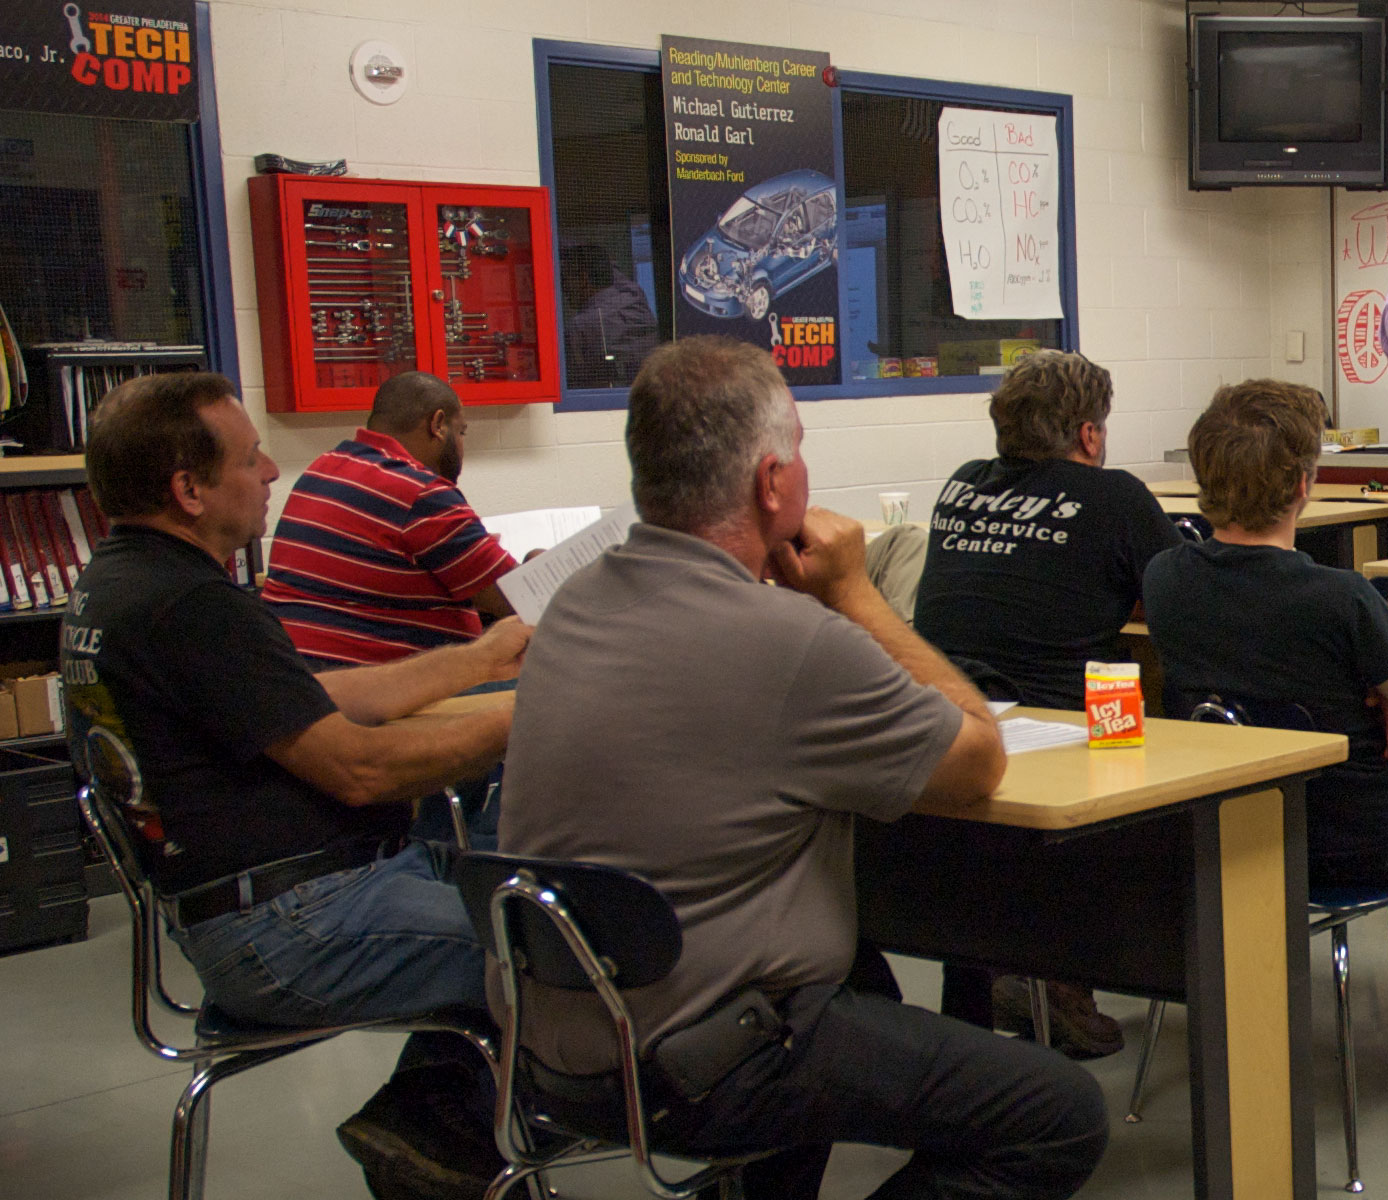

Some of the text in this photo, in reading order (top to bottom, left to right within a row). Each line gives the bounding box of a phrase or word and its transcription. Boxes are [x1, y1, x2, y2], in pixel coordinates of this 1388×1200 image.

[110, 14, 139, 26] GREATER
[141, 17, 189, 31] PHILADELPHIA
[41, 45, 65, 63] Jr.
[88, 22, 191, 63] TECH
[71, 52, 191, 95] COMP
[669, 47, 816, 77] Reading/Muhlenberg Career
[671, 70, 790, 94] and Technology Center
[673, 96, 795, 122] Michael Gutierrez
[674, 122, 754, 145] Ronald Garl
[947, 120, 981, 146] Good
[675, 150, 729, 167] Sponsored by
[727, 170, 744, 183] Ford
[307, 204, 373, 220] Snap-on
[781, 323, 834, 345] TECH
[773, 345, 835, 368] COMP
[939, 479, 1082, 520] Werley's
[930, 512, 1068, 545] Auto Service
[942, 534, 1017, 555] Center
[1090, 699, 1122, 722] Icy
[1099, 714, 1137, 735] Tea
